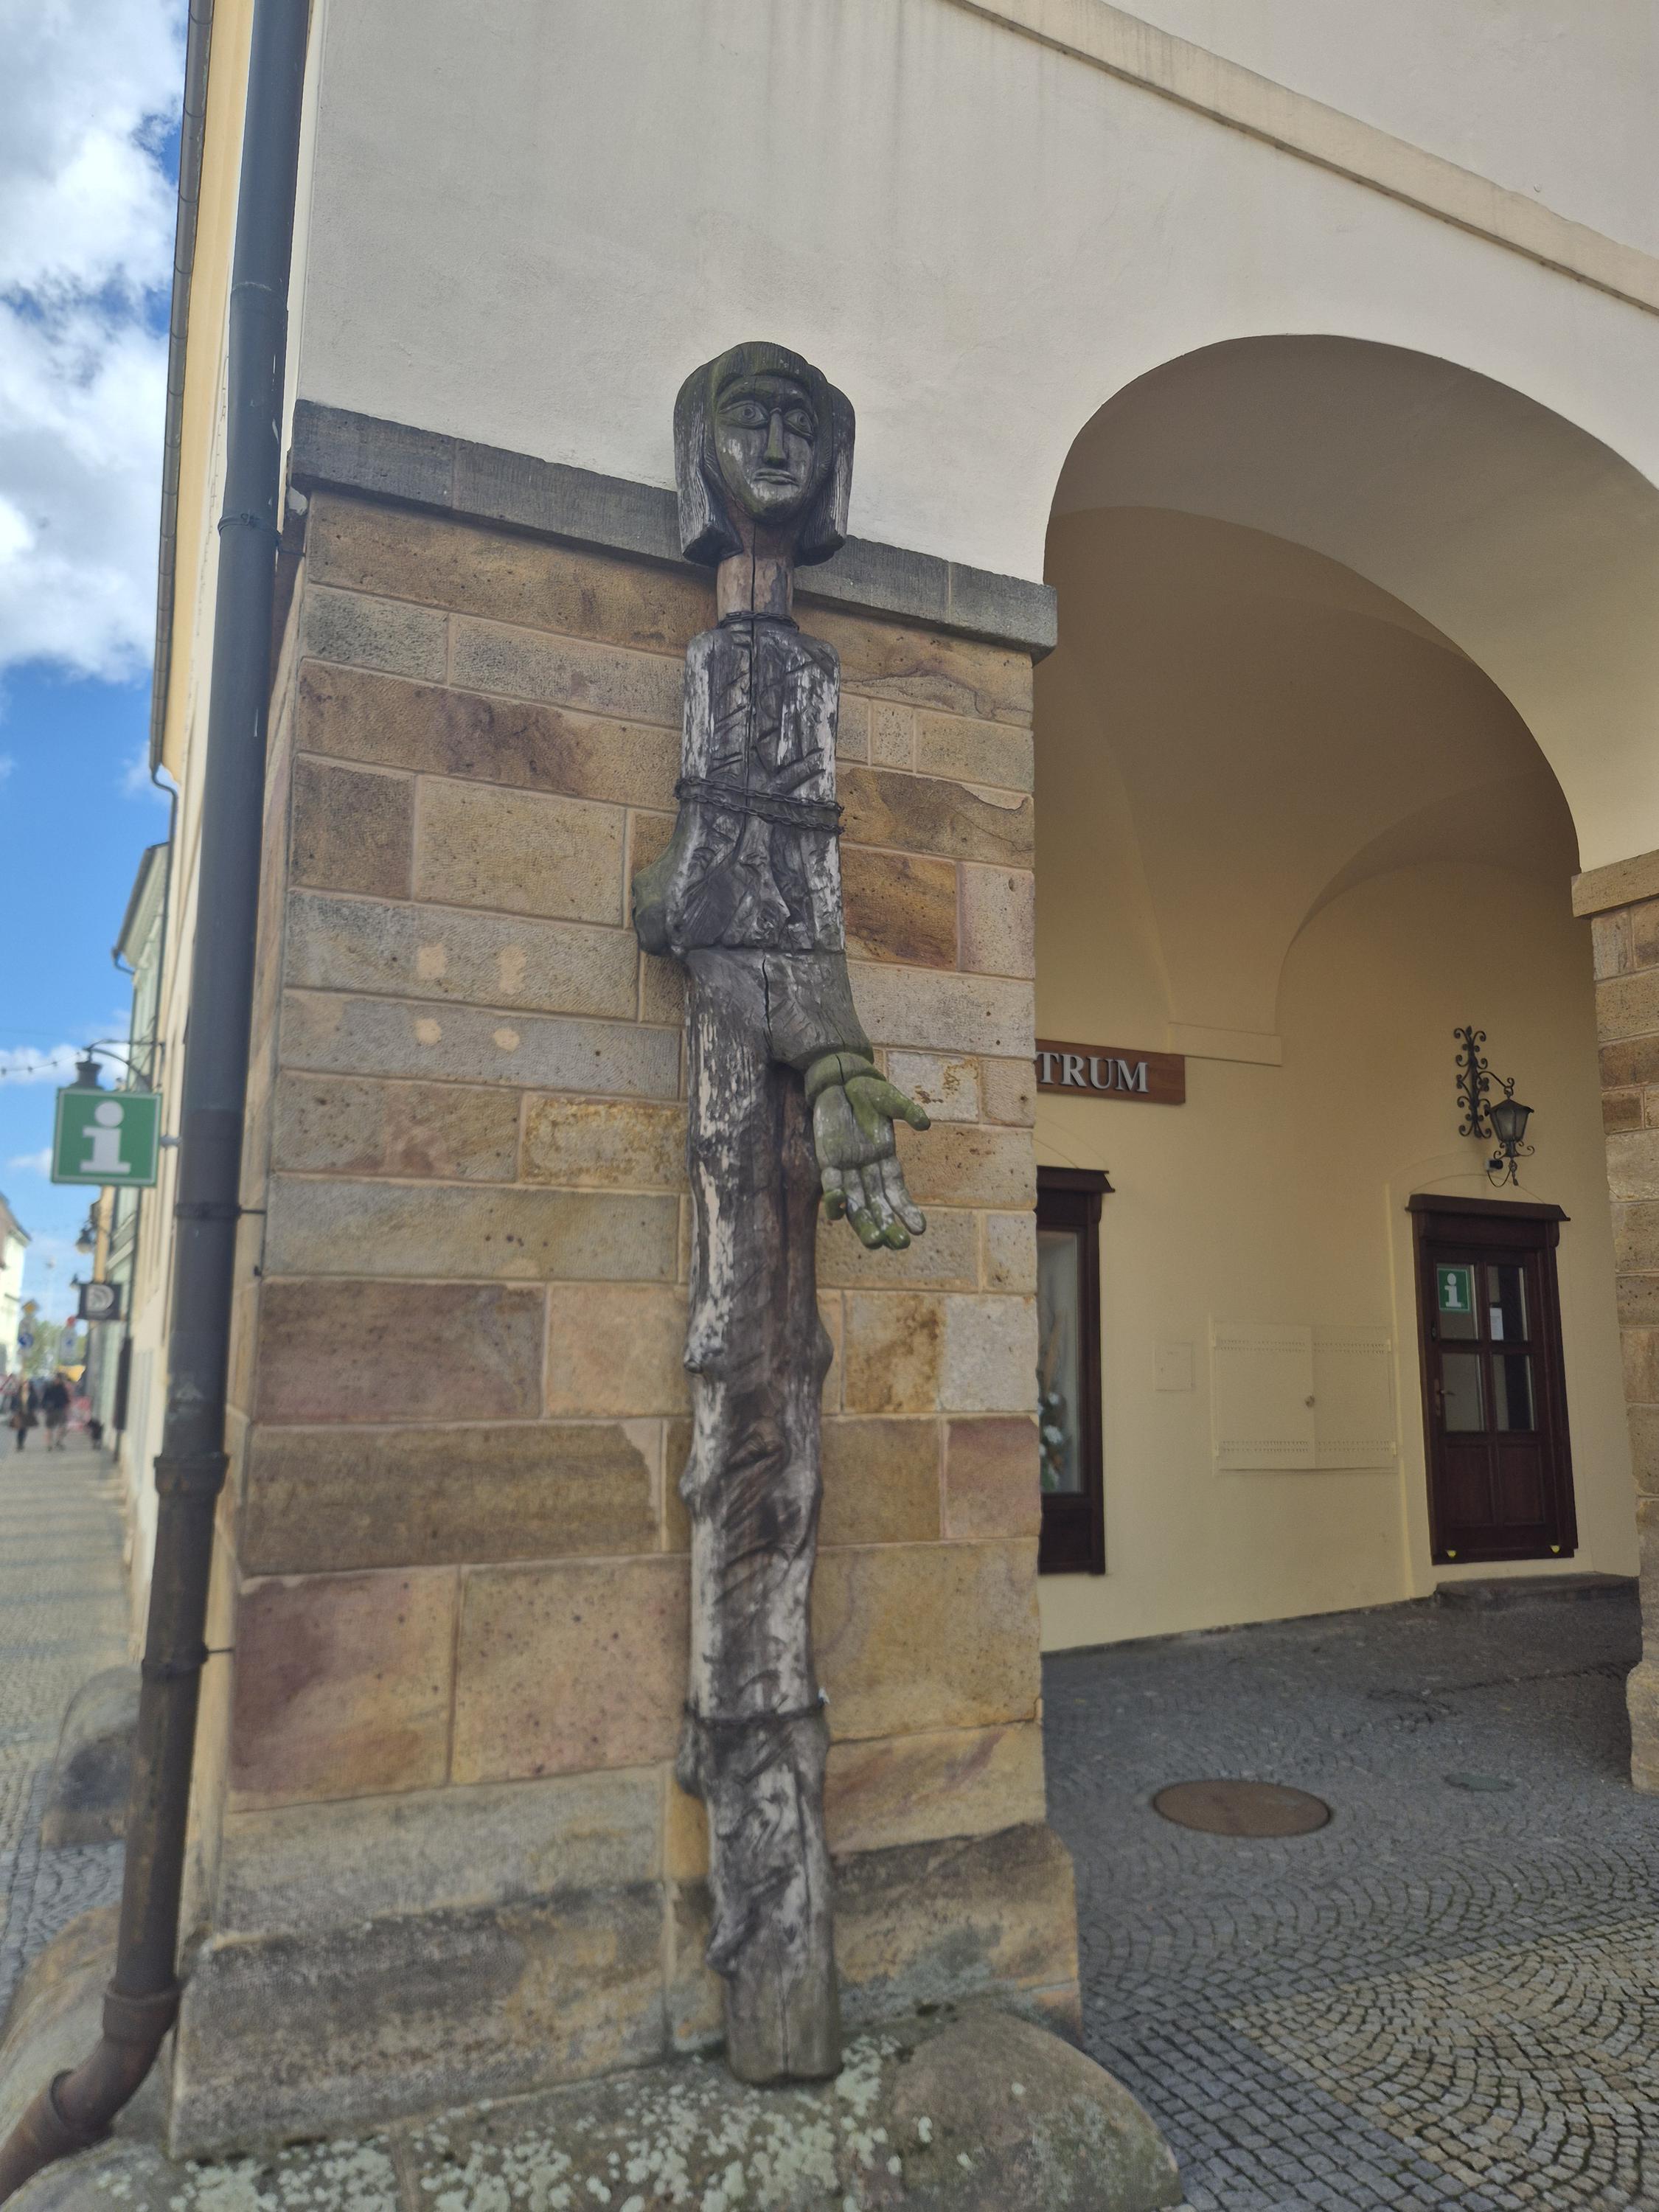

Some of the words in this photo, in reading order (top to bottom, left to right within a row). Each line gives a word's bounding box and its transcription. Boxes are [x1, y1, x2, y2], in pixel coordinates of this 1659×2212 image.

[1036, 1051, 1149, 1093] TRUM
[80, 1100, 131, 1174] i
[1444, 1273, 1461, 1307] i
